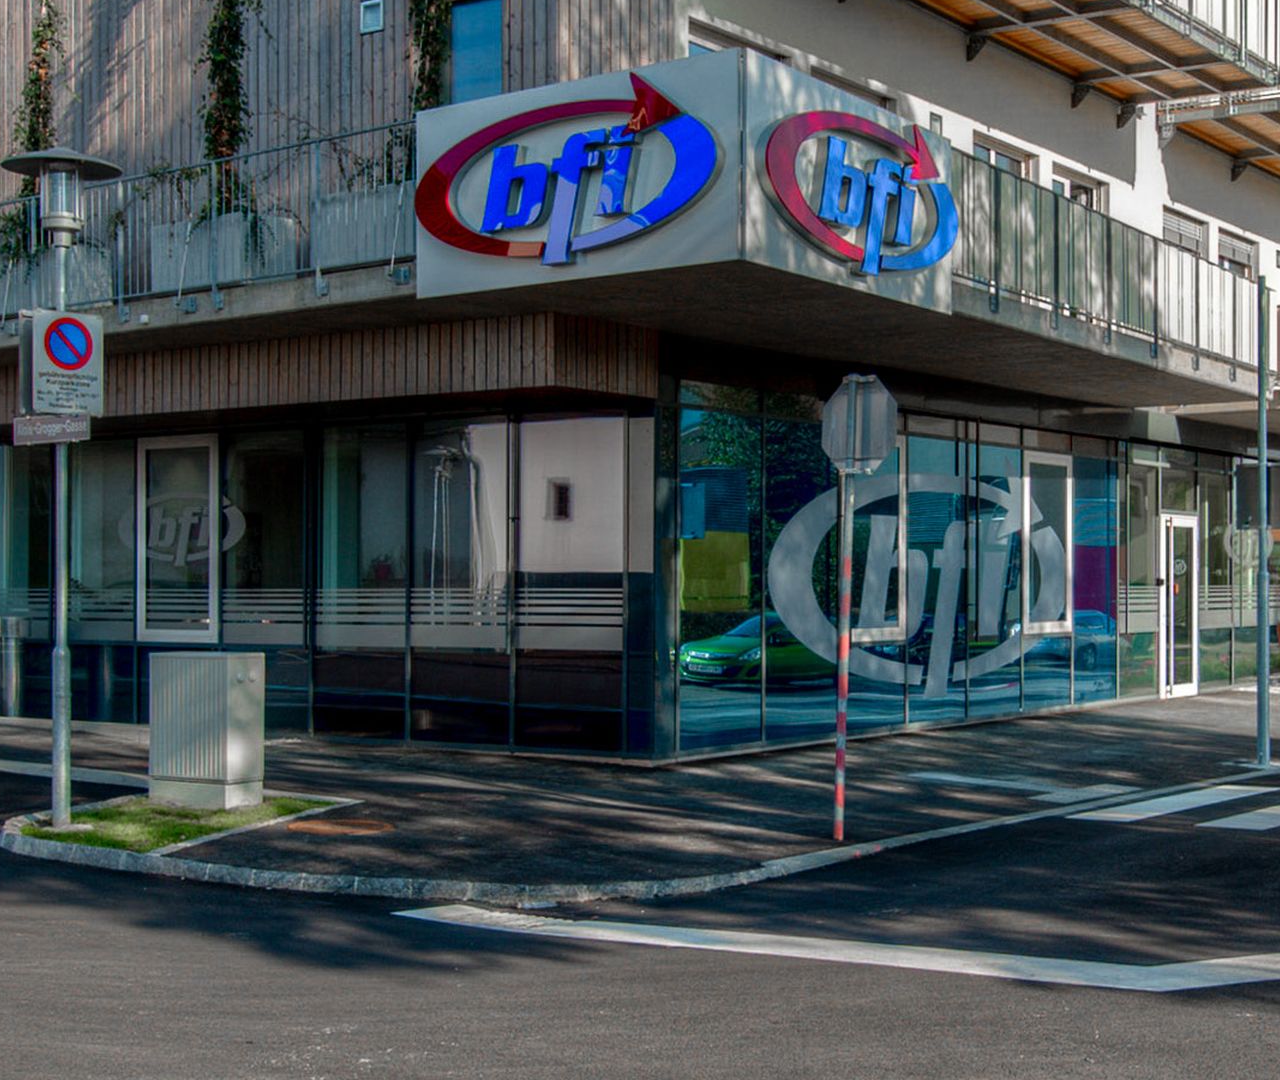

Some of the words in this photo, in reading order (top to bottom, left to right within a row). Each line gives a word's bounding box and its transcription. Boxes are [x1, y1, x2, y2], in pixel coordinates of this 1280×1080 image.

[480, 125, 634, 265] bfi
[817, 136, 918, 276] bfi
[858, 514, 1010, 698] bfi
